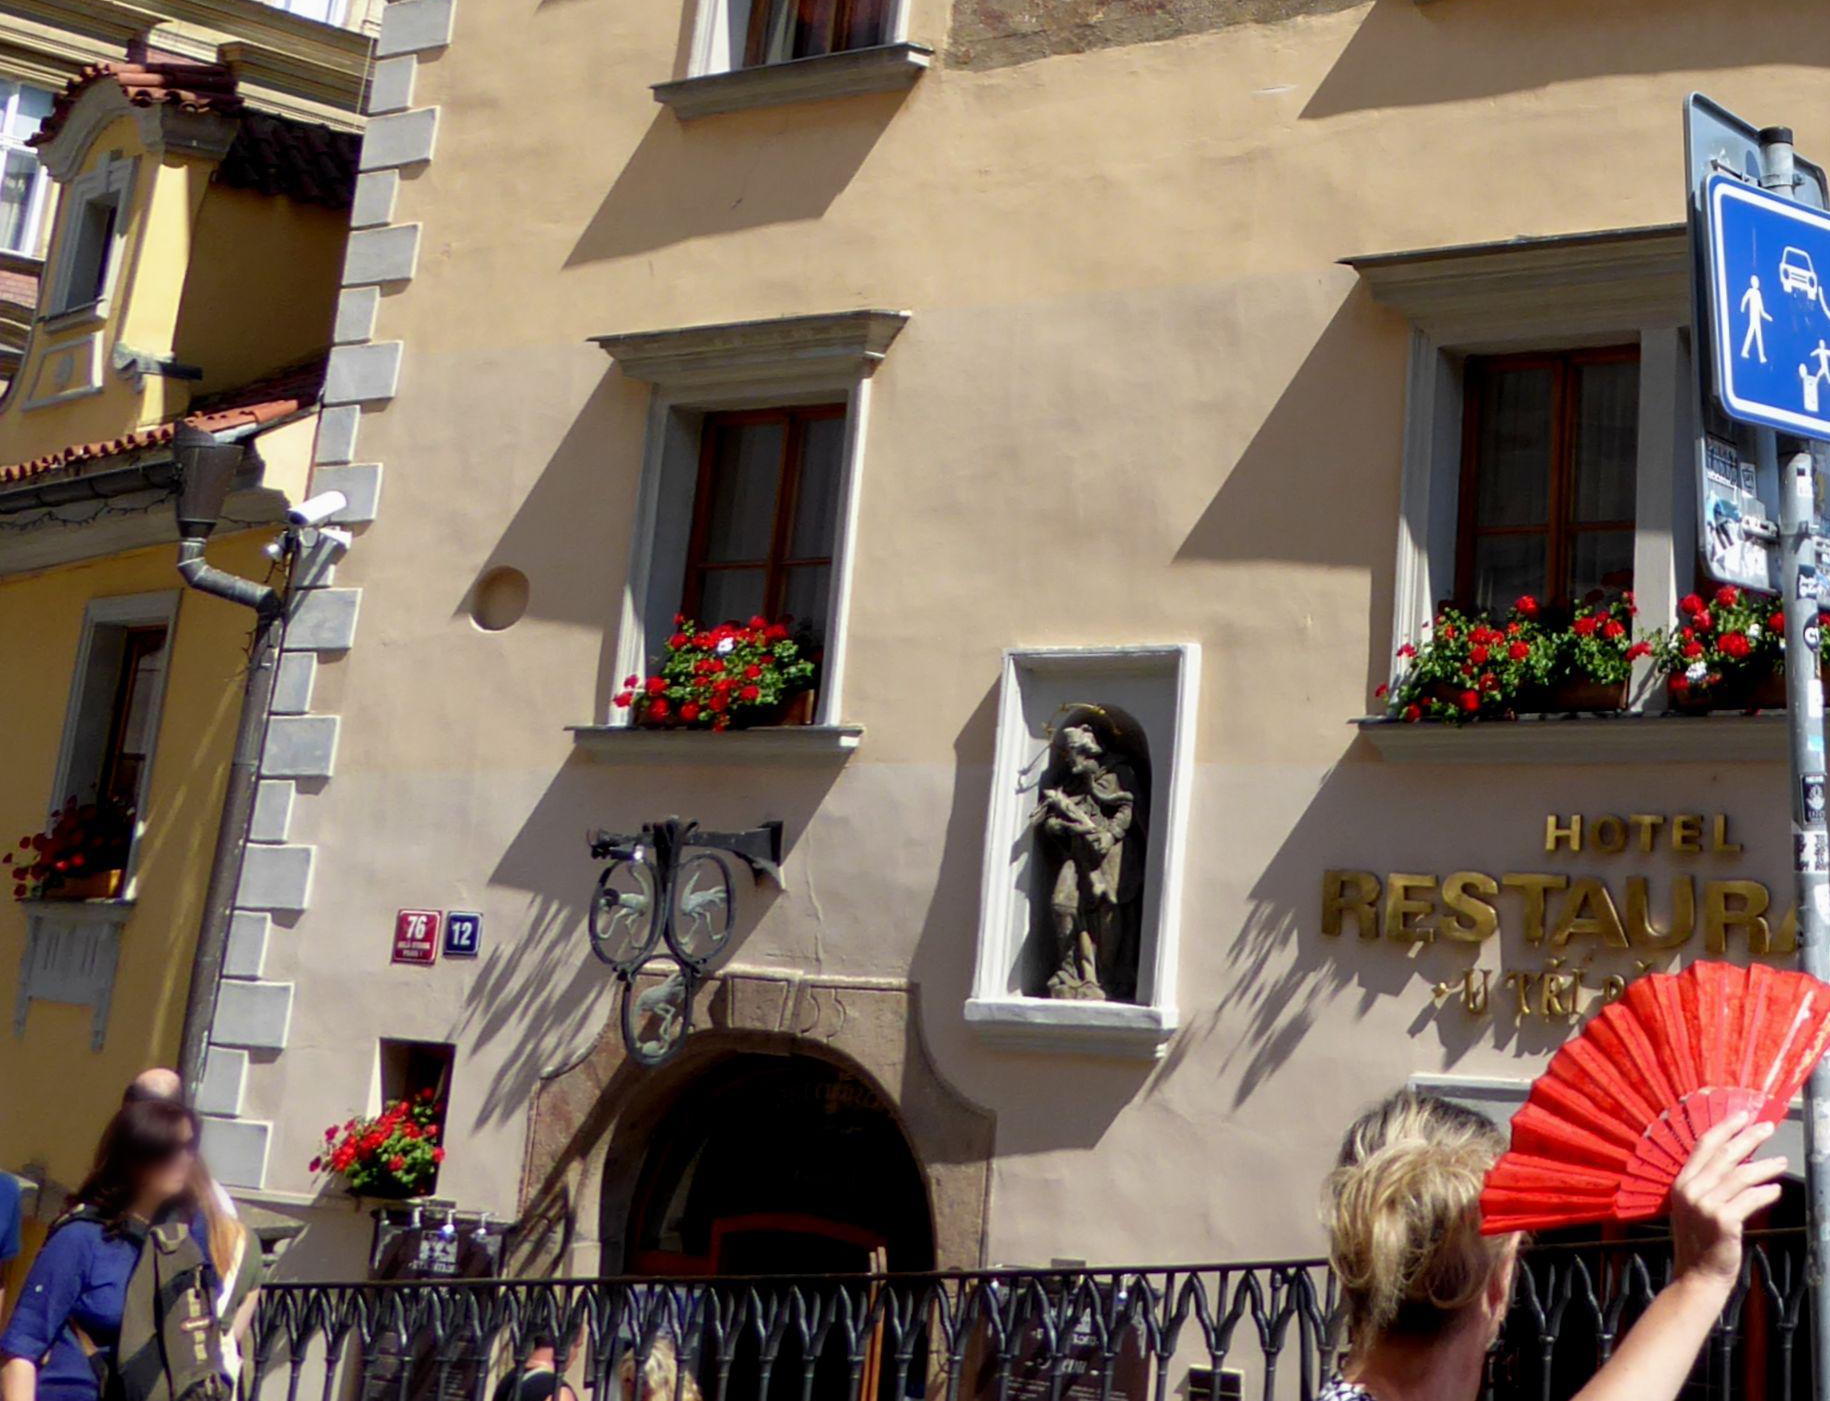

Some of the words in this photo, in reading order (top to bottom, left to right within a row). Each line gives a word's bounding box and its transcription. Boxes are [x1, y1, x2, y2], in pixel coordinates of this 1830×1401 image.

[1544, 813, 1744, 855] HOTEL
[406, 915, 428, 940] 76
[452, 921, 473, 946] 12
[1463, 968, 1493, 1014] U
